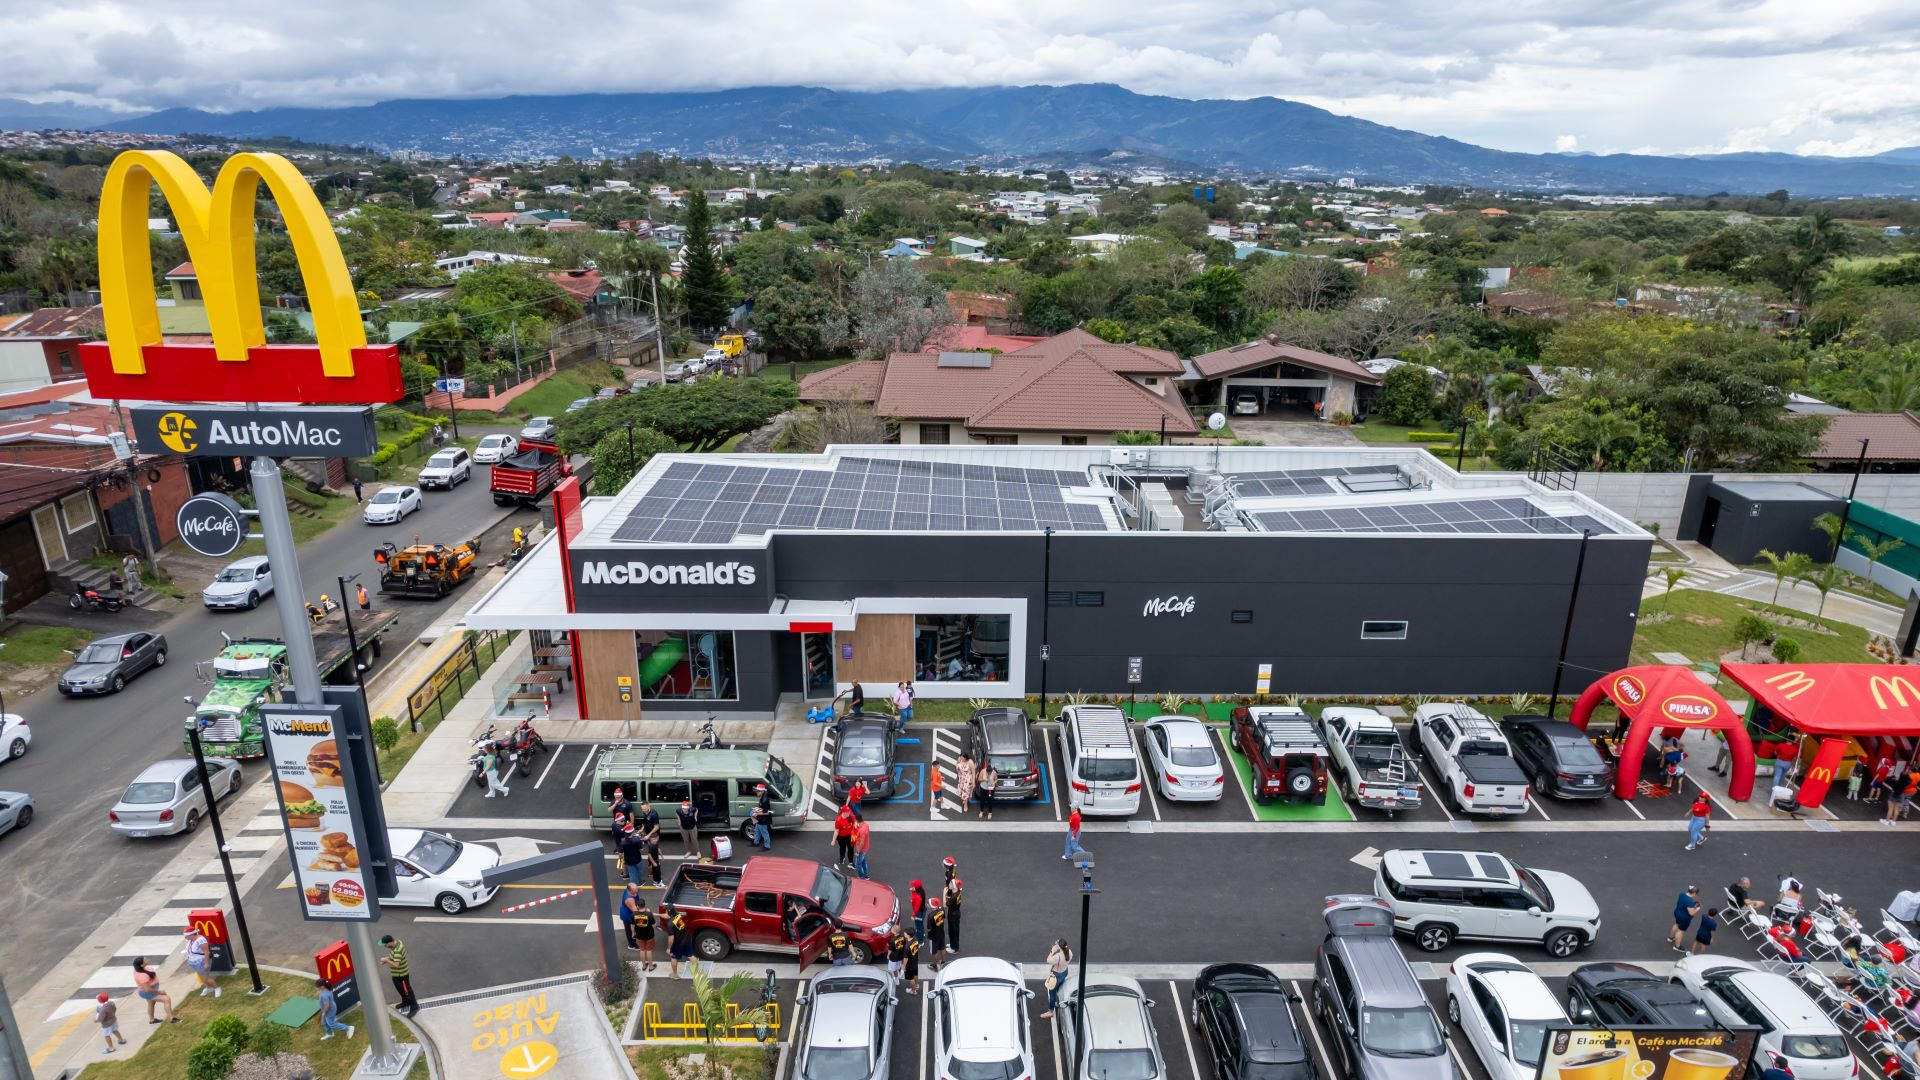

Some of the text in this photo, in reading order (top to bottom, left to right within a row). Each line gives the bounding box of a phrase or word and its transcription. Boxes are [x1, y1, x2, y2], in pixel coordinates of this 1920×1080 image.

[209, 419, 341, 446] AutoMac
[184, 515, 235, 536] McCafé
[582, 561, 756, 585] McDonald's
[1143, 595, 1195, 617] McCafé
[1618, 679, 1641, 702] PIPASA
[1669, 703, 1709, 715] PIPASA
[270, 719, 332, 736] McMenú
[472, 993, 547, 1029] Mac
[472, 1010, 560, 1051] Auto
[1576, 1037, 1587, 1045] El
[1589, 1037, 1622, 1046] aroa
[1638, 1036, 1664, 1046] Café
[1678, 1036, 1723, 1046] McCafé
